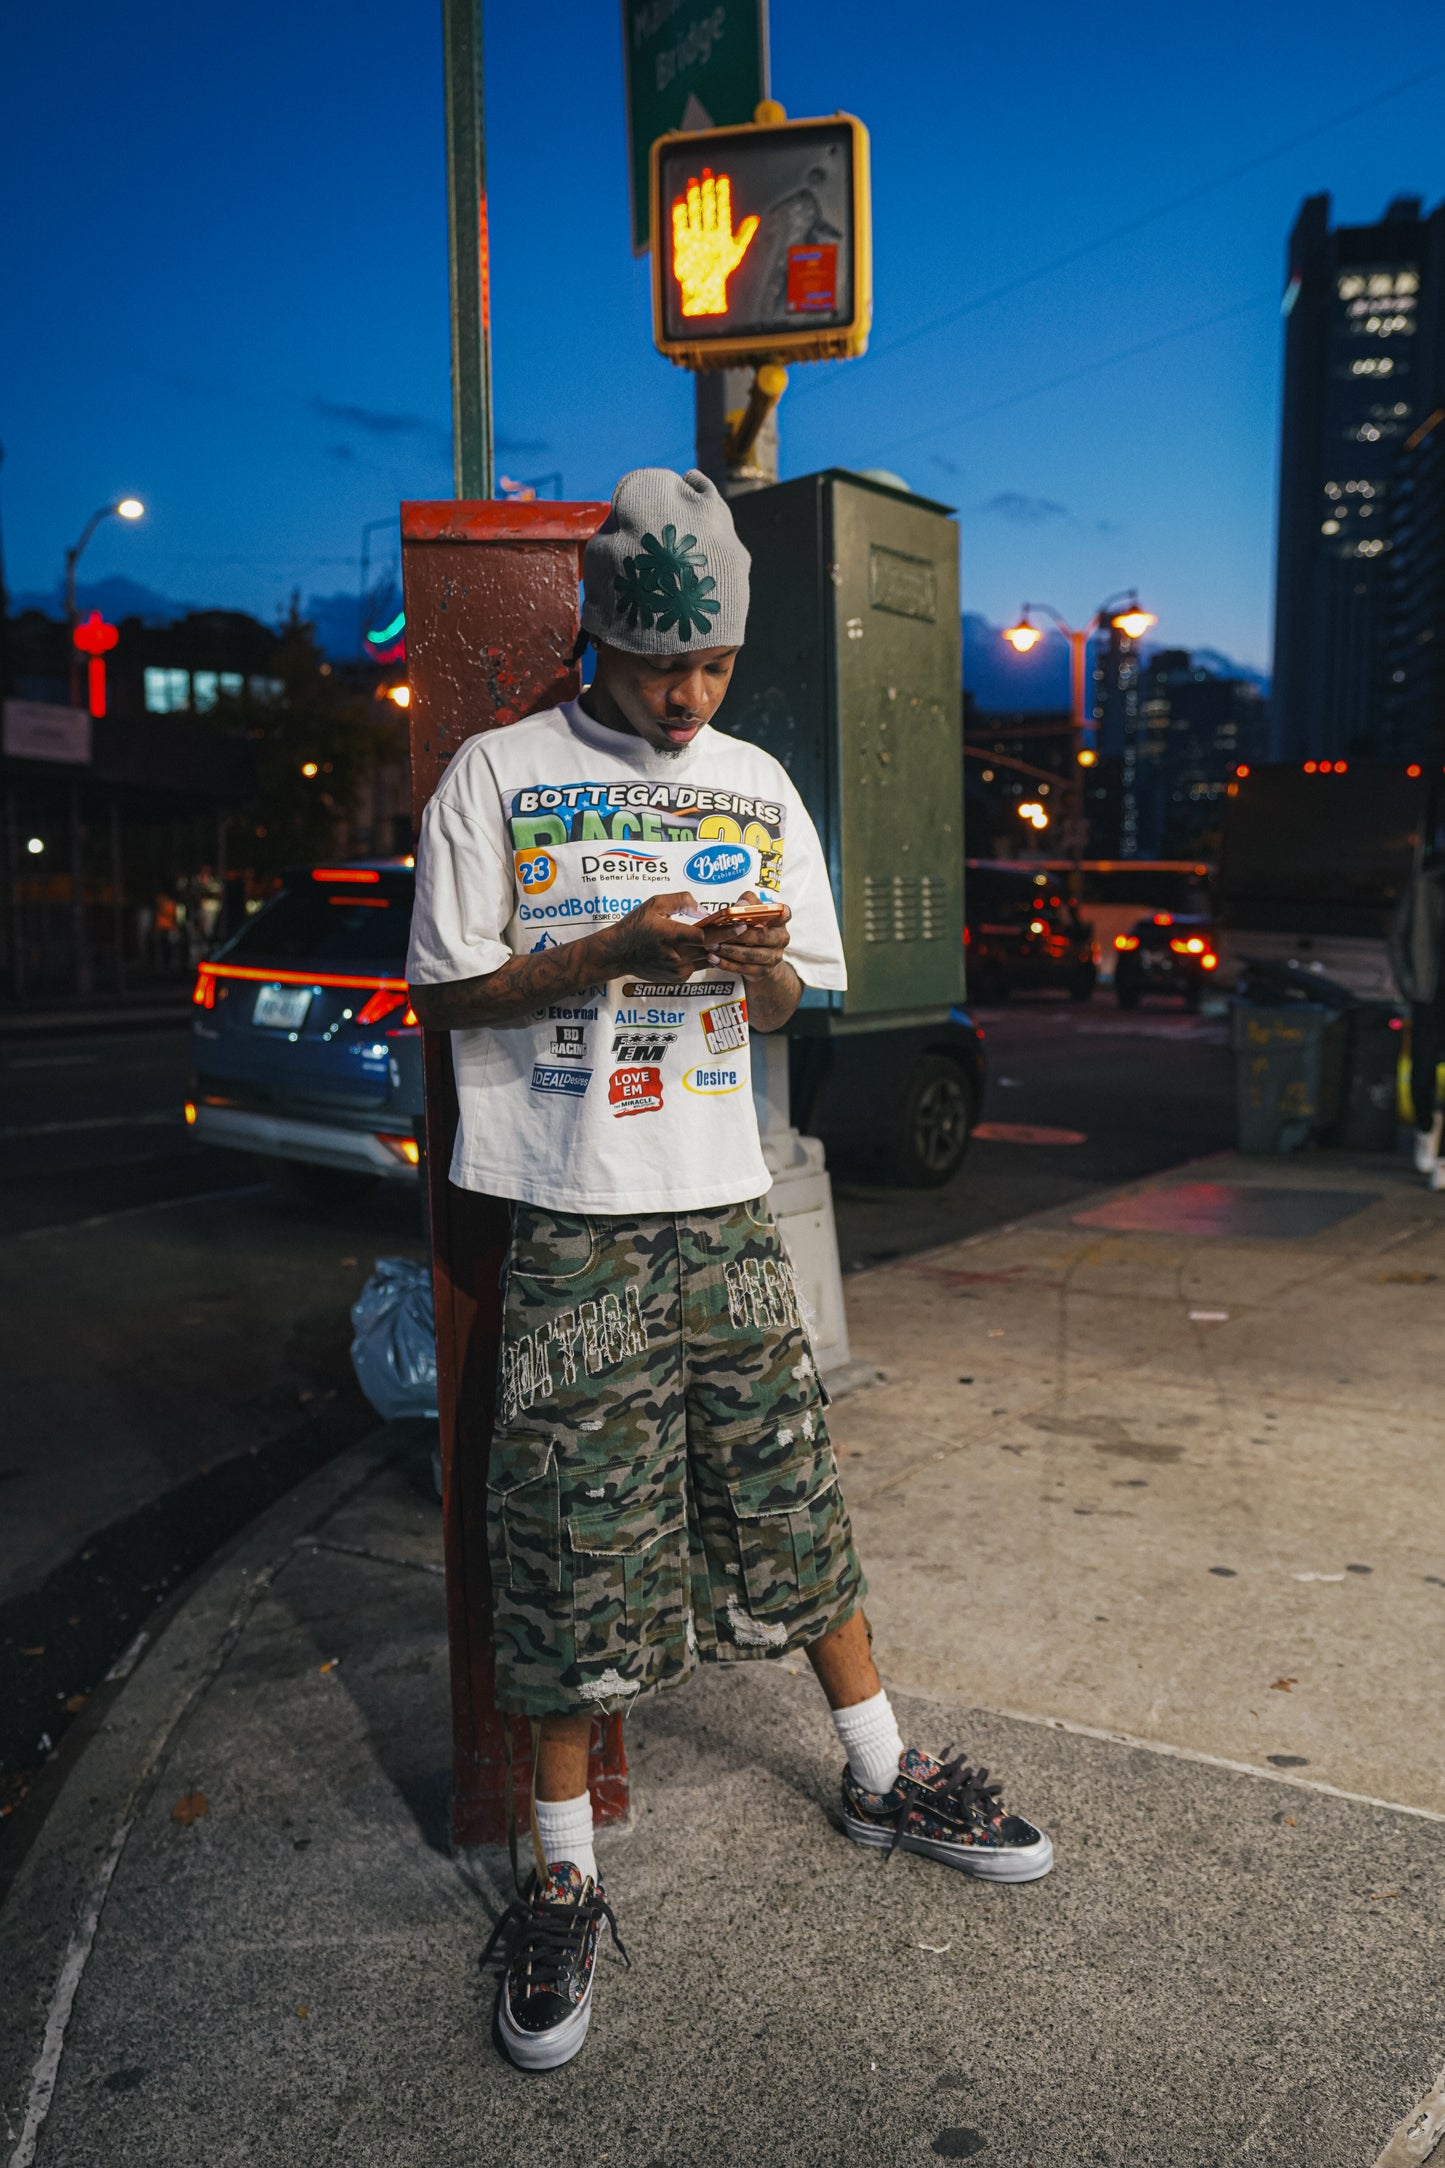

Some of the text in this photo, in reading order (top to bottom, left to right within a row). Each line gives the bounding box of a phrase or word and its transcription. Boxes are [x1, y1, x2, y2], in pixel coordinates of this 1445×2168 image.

[519, 784, 781, 826] BOTTEGA DESIRES
[518, 855, 551, 886] 23
[581, 855, 669, 875] Desires
[693, 852, 746, 880] Bottega
[581, 875, 597, 883] The
[600, 874, 623, 882] Better
[642, 874, 671, 882] Experts
[519, 895, 643, 921] GoodBottega
[633, 983, 733, 996] SmartDesires
[548, 1006, 599, 1021] Eternal
[614, 1008, 685, 1024] All-Star
[709, 1001, 744, 1031] RUFF
[563, 1028, 580, 1041] BD
[550, 1042, 588, 1056] RACING
[616, 1045, 668, 1063] EM
[614, 1071, 651, 1087] LOVE
[696, 1068, 737, 1087] Desire
[623, 1084, 644, 1097] EM
[621, 1097, 653, 1108] MIRACLE
